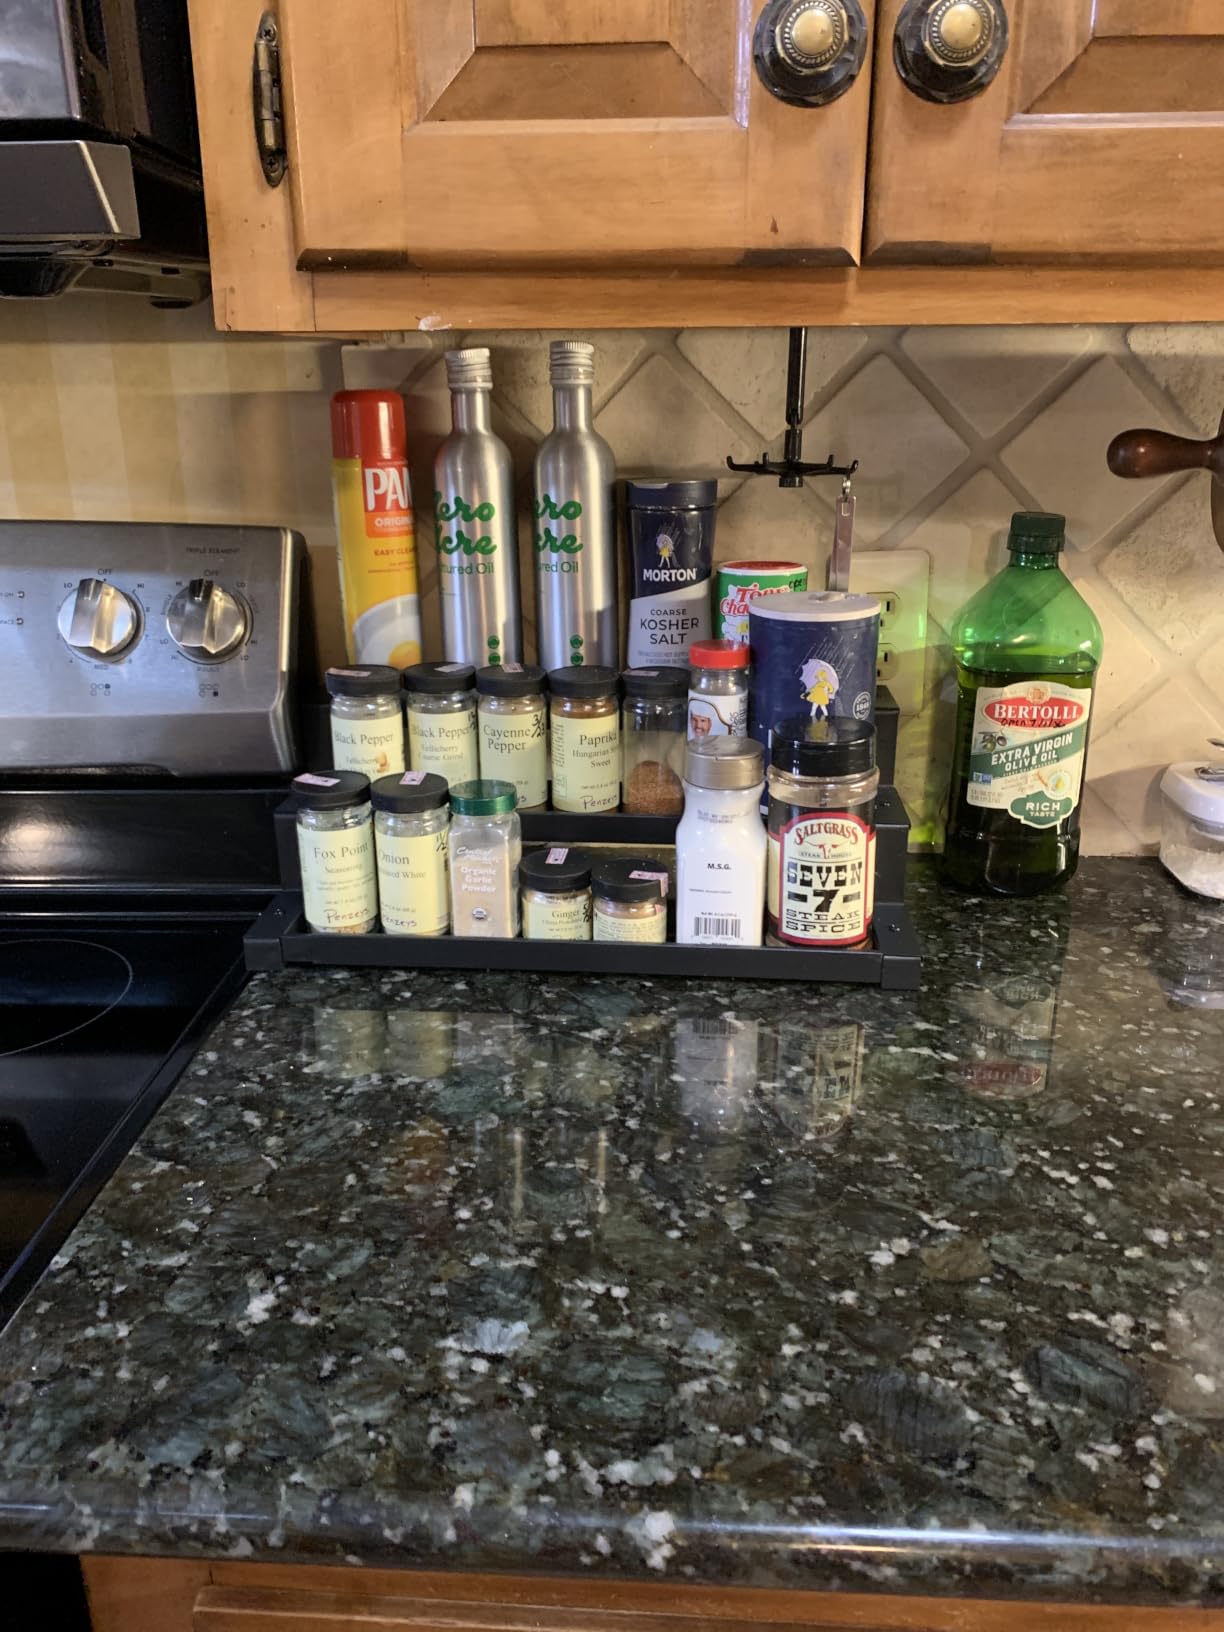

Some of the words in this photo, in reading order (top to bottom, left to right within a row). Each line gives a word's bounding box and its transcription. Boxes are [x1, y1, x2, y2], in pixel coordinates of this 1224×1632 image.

[476, 562, 494, 574] Oil
[561, 560, 579, 573] Oil
[643, 568, 697, 582] MORTON
[650, 608, 687, 616] COARSE
[640, 617, 699, 631] KOSHER
[650, 633, 687, 645] SALT
[994, 703, 1078, 719] BERTOLLI
[438, 726, 470, 740] Pepper
[483, 724, 531, 740] Cayenne
[360, 733, 393, 747] Pepper
[488, 738, 526, 753] Pepper
[991, 746, 1030, 765] EXTRA
[1034, 732, 1073, 754] VIRGIN
[591, 759, 611, 768] Sweet
[1005, 755, 1037, 771] OLIVE
[1041, 750, 1057, 762] OIL
[1026, 802, 1060, 811] RICH
[794, 822, 859, 845] SALTGRASS
[314, 847, 336, 859] Fox
[787, 861, 863, 888] SEVEN
[813, 889, 840, 913] 7
[786, 909, 860, 921] STEAK
[786, 920, 861, 933] SPICE
